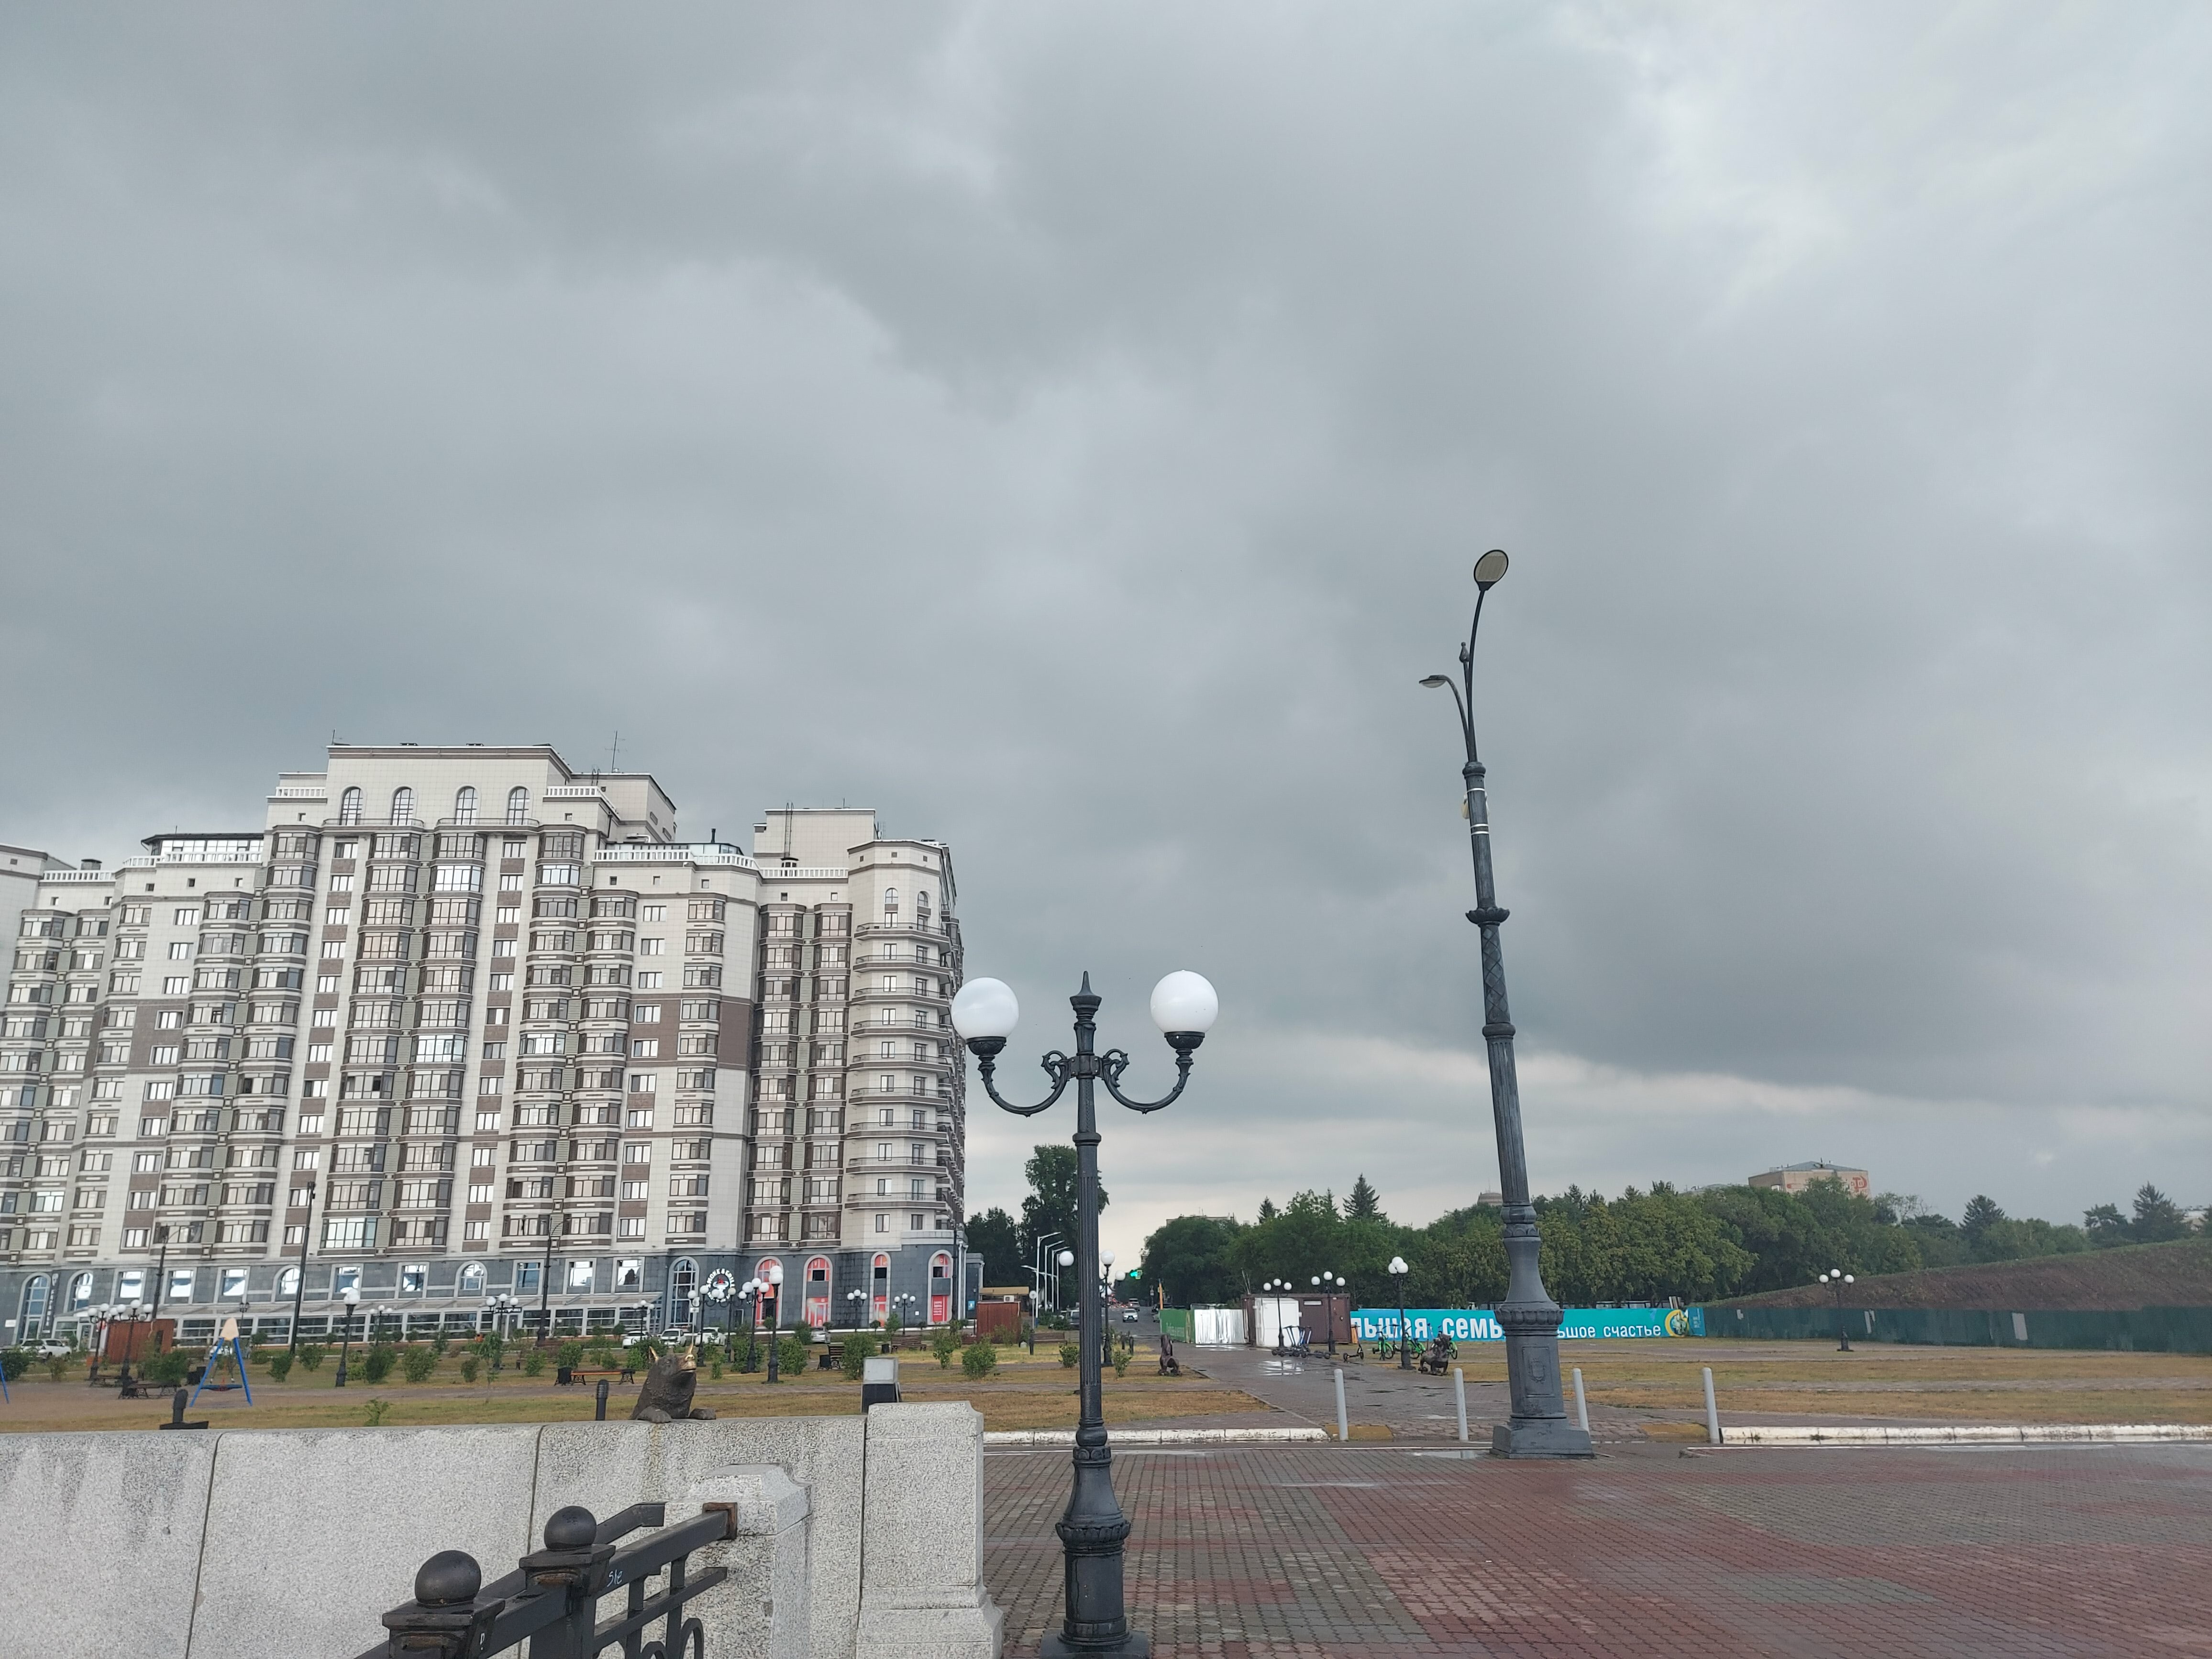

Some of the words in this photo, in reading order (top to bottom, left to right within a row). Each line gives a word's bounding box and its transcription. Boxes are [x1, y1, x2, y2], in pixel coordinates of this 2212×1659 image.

[1350, 1318, 1427, 1338] льшая
[1442, 1317, 1503, 1338] семь
[1557, 1326, 1596, 1338] ьшое
[1604, 1325, 1661, 1337] счастье
